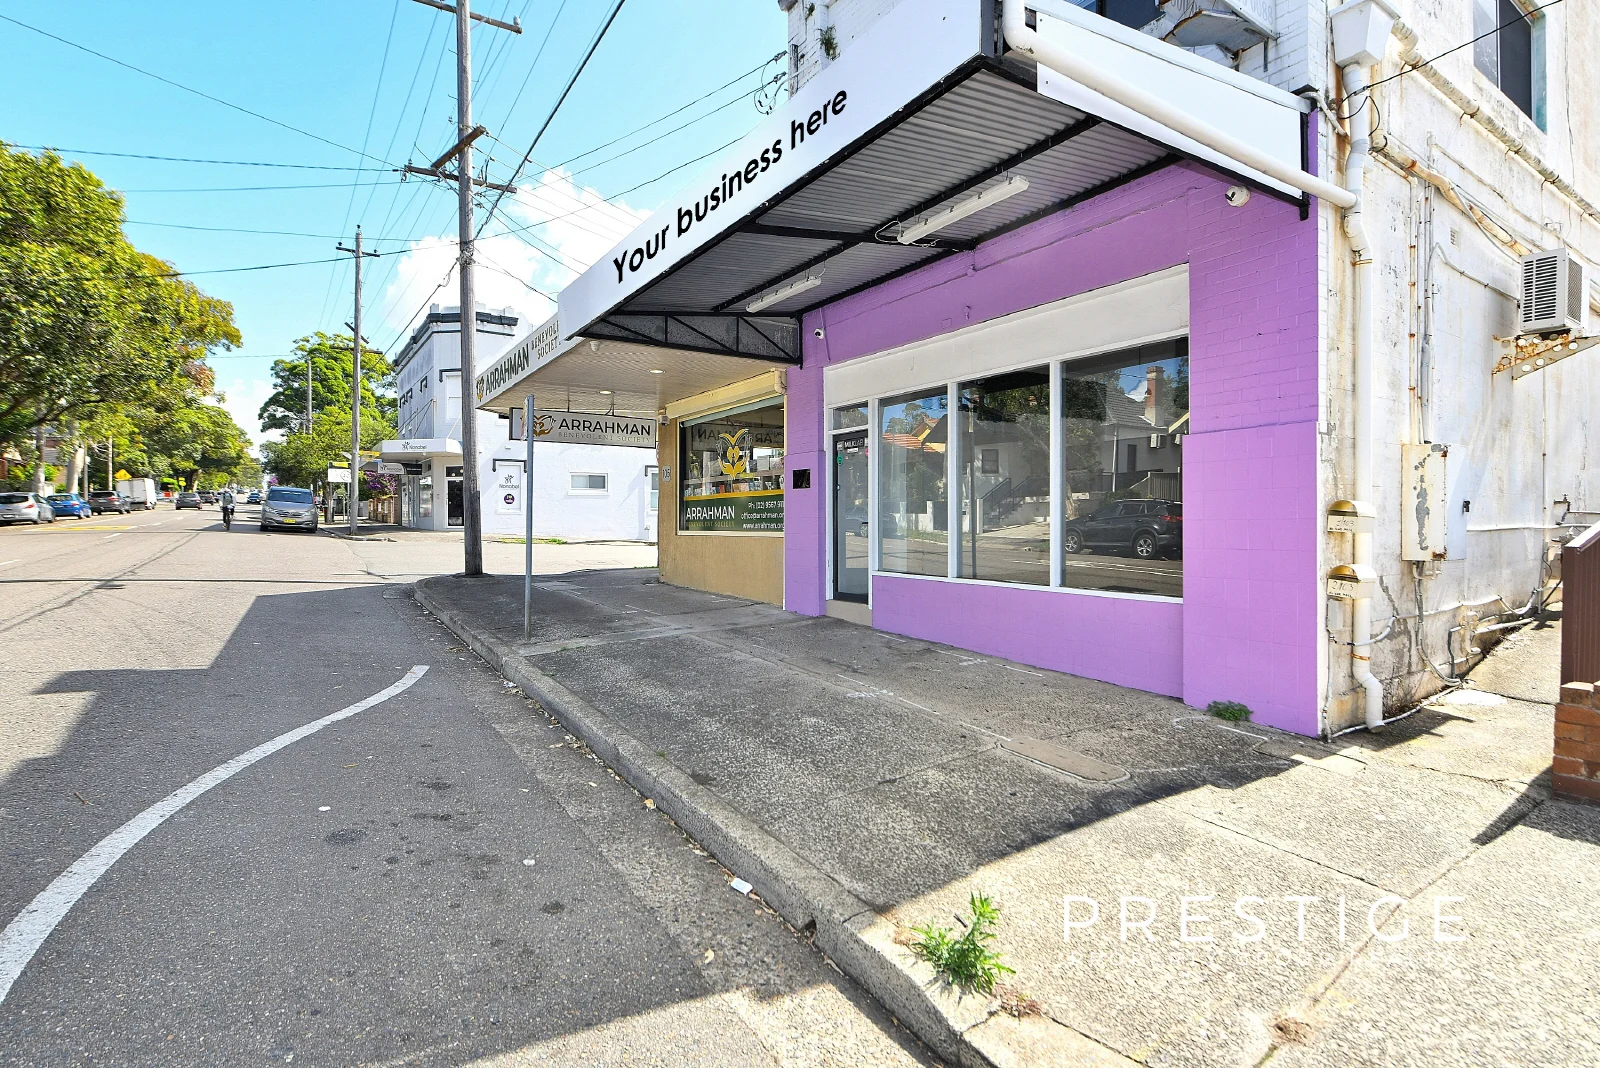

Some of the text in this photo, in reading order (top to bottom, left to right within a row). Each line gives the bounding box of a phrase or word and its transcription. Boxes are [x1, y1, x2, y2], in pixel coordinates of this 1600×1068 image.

[612, 90, 848, 284] Your business here
[537, 335, 561, 360] SOCIET
[486, 343, 530, 396] ARRAHMAN
[558, 418, 651, 436] ARRAHMAN
[558, 431, 613, 441] BENEVOLENT
[686, 505, 735, 520] ARRAHMAN
